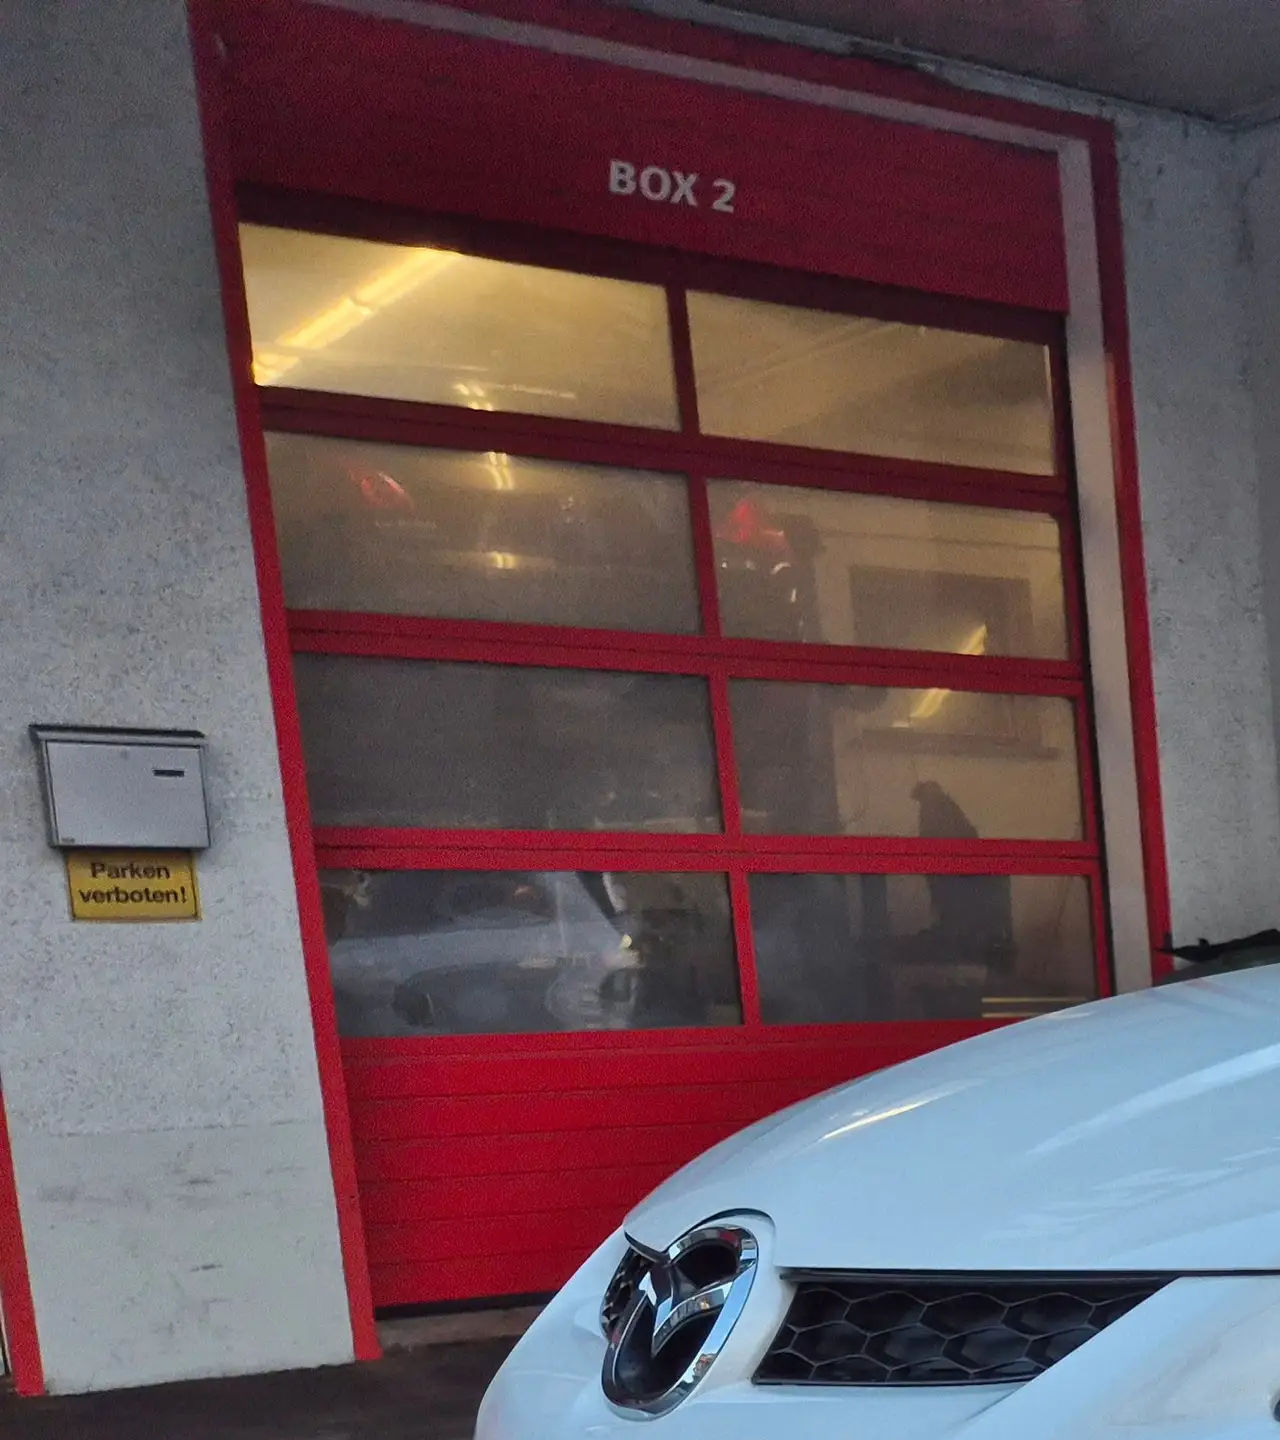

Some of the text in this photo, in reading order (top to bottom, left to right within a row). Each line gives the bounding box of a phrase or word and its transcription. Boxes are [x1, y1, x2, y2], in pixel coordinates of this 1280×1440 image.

[608, 158, 737, 214] BOX 2
[90, 861, 171, 880] Parken
[78, 885, 188, 905] verboten!
